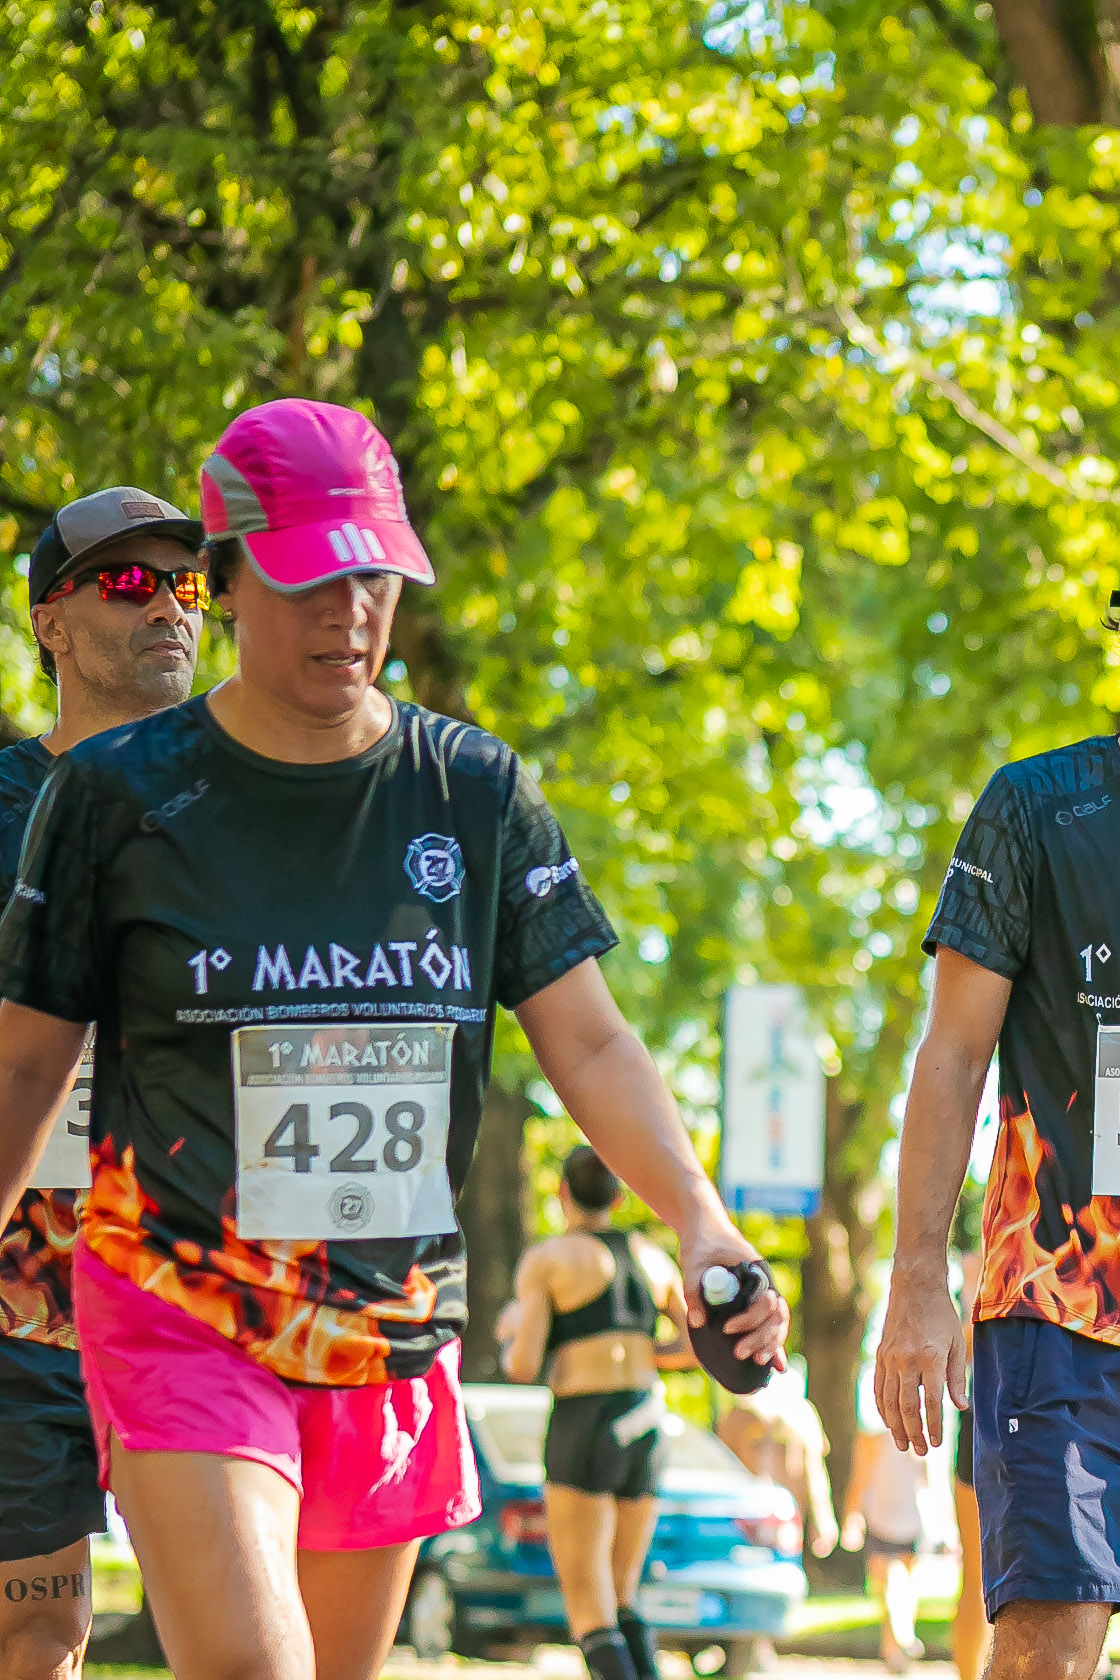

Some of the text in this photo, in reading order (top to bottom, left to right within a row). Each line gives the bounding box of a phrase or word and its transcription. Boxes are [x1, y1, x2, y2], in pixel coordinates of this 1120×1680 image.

[252, 926, 472, 992] MARATÓN
[300, 1032, 430, 1067] MARATÓN
[264, 1100, 426, 1173] 428
